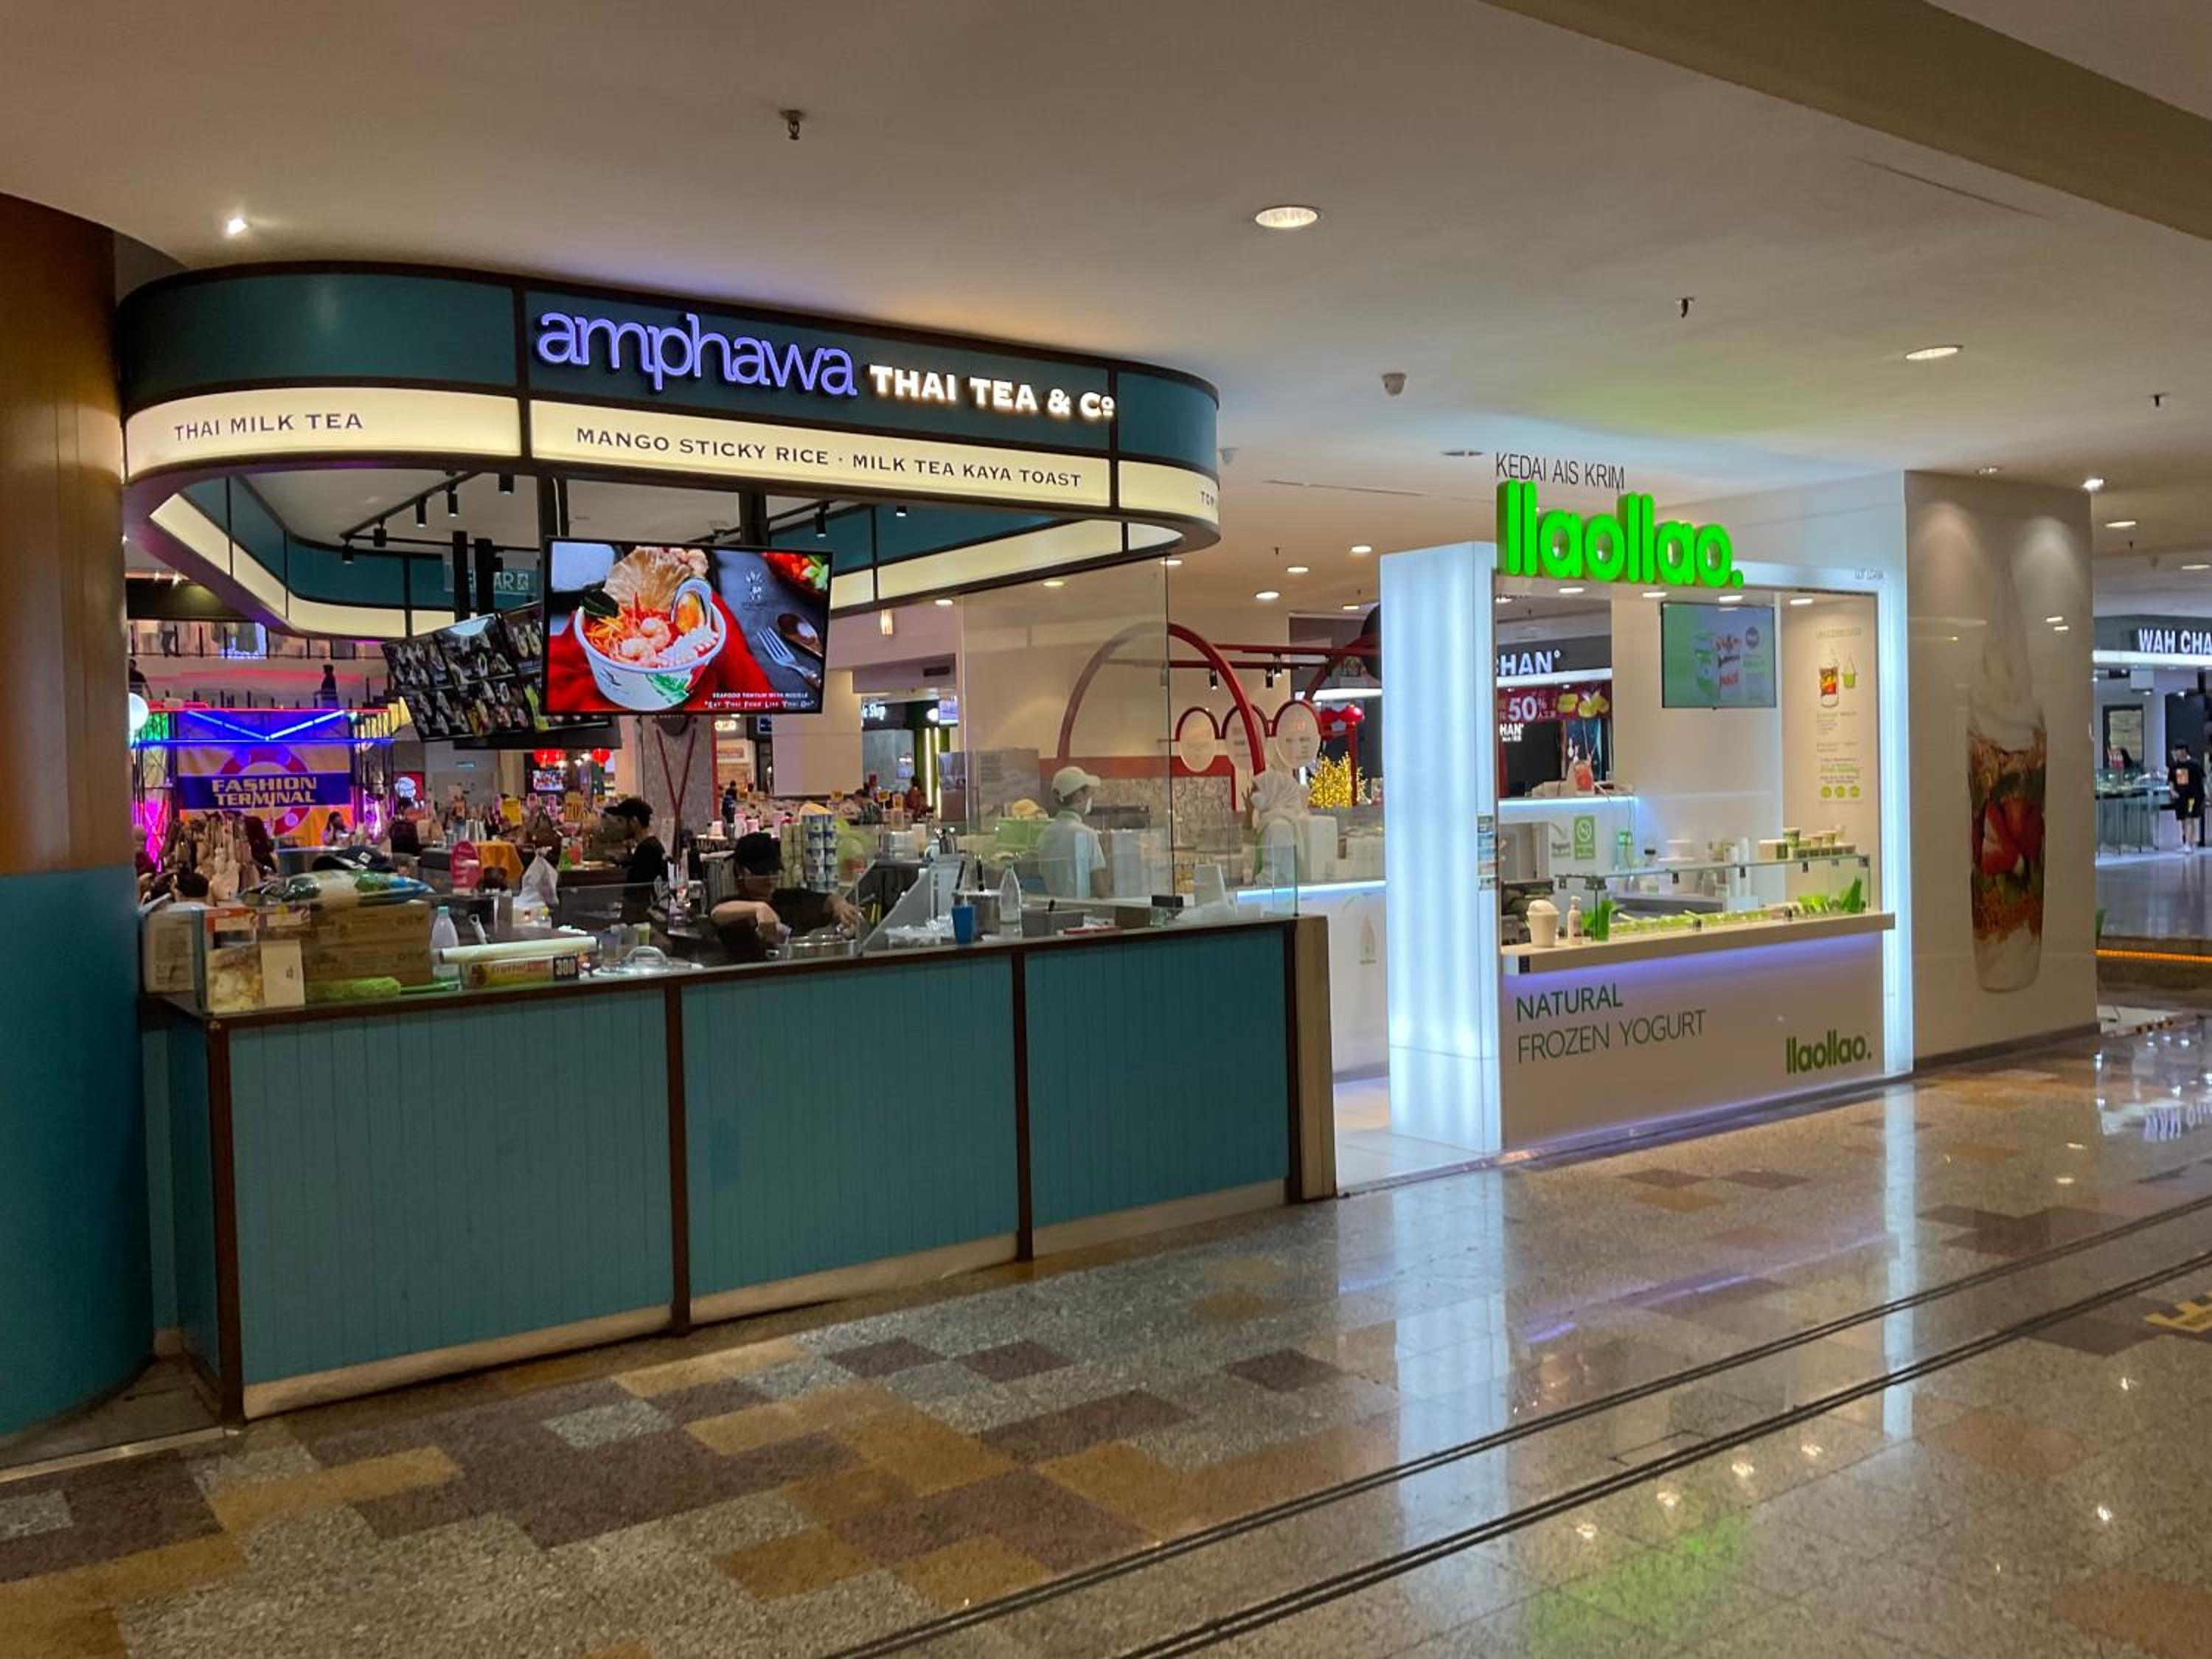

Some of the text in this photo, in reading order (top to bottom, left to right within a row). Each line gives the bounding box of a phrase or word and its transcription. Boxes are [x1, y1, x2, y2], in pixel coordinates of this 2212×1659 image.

[537, 312, 858, 396] amphawa
[869, 364, 956, 403] THAI
[970, 377, 1038, 411] TEA
[1047, 389, 1071, 416] &
[174, 413, 364, 441] THAI MILK TEA
[577, 428, 1082, 487] MANGO STICKY RICE MILK TEA KAYA TOAST
[1496, 453, 1625, 490] KEDAI AIS KRIM
[2138, 629, 2176, 653] WAH
[212, 776, 317, 793] FASHION
[214, 790, 316, 806] TERMINAL
[555, 959, 576, 976] 300
[1517, 983, 1624, 1022] NATURAL
[1518, 1009, 1706, 1064] FROZEN YOGURT
